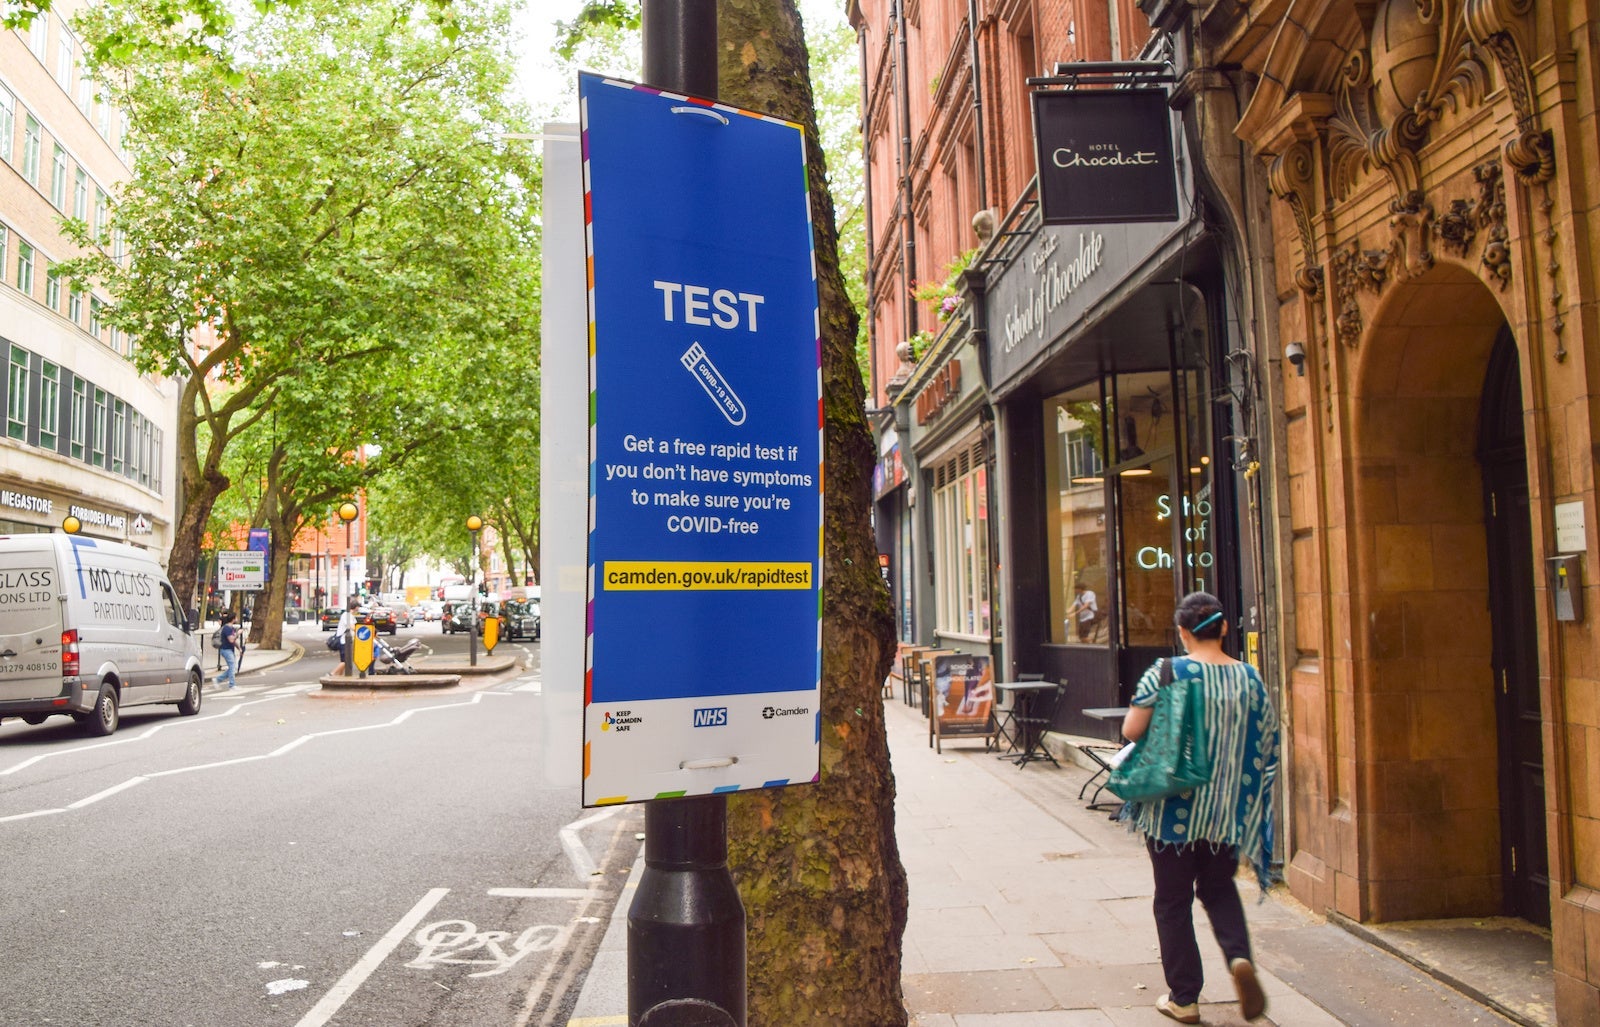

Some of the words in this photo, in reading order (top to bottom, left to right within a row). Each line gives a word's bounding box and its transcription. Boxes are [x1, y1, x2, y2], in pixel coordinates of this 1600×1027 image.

[1005, 288, 1033, 353] School
[1035, 274, 1045, 339] of
[1046, 229, 1102, 313] Chocolate
[654, 280, 765, 333] TEST
[699, 363, 726, 398] COVID-19
[723, 395, 739, 415] TEST
[623, 435, 654, 453] Get
[659, 440, 669, 454] a
[674, 438, 706, 456] free
[710, 443, 750, 461] rapid
[755, 444, 784, 461] test
[788, 446, 798, 462] if
[606, 464, 638, 481] you
[691, 465, 729, 483] have
[733, 470, 812, 488] symptoms
[1, 490, 53, 514] MEGASTORE
[631, 489, 649, 505] to
[654, 490, 700, 507] make
[704, 496, 739, 509] sure
[71, 505, 105, 525] FORBIDDEN
[105, 512, 127, 529] PLANET
[667, 515, 759, 535] COVID-free
[89, 567, 112, 593] MD
[114, 570, 151, 597] GLASS
[608, 568, 809, 587] camden.gov.uk/rapidtest
[29, 592, 51, 603] LTD
[94, 602, 140, 620] PARTITIONS
[143, 605, 154, 621] LTD
[26, 662, 57, 671] 408150
[695, 709, 727, 726] NHS
[775, 707, 809, 717] Camden
